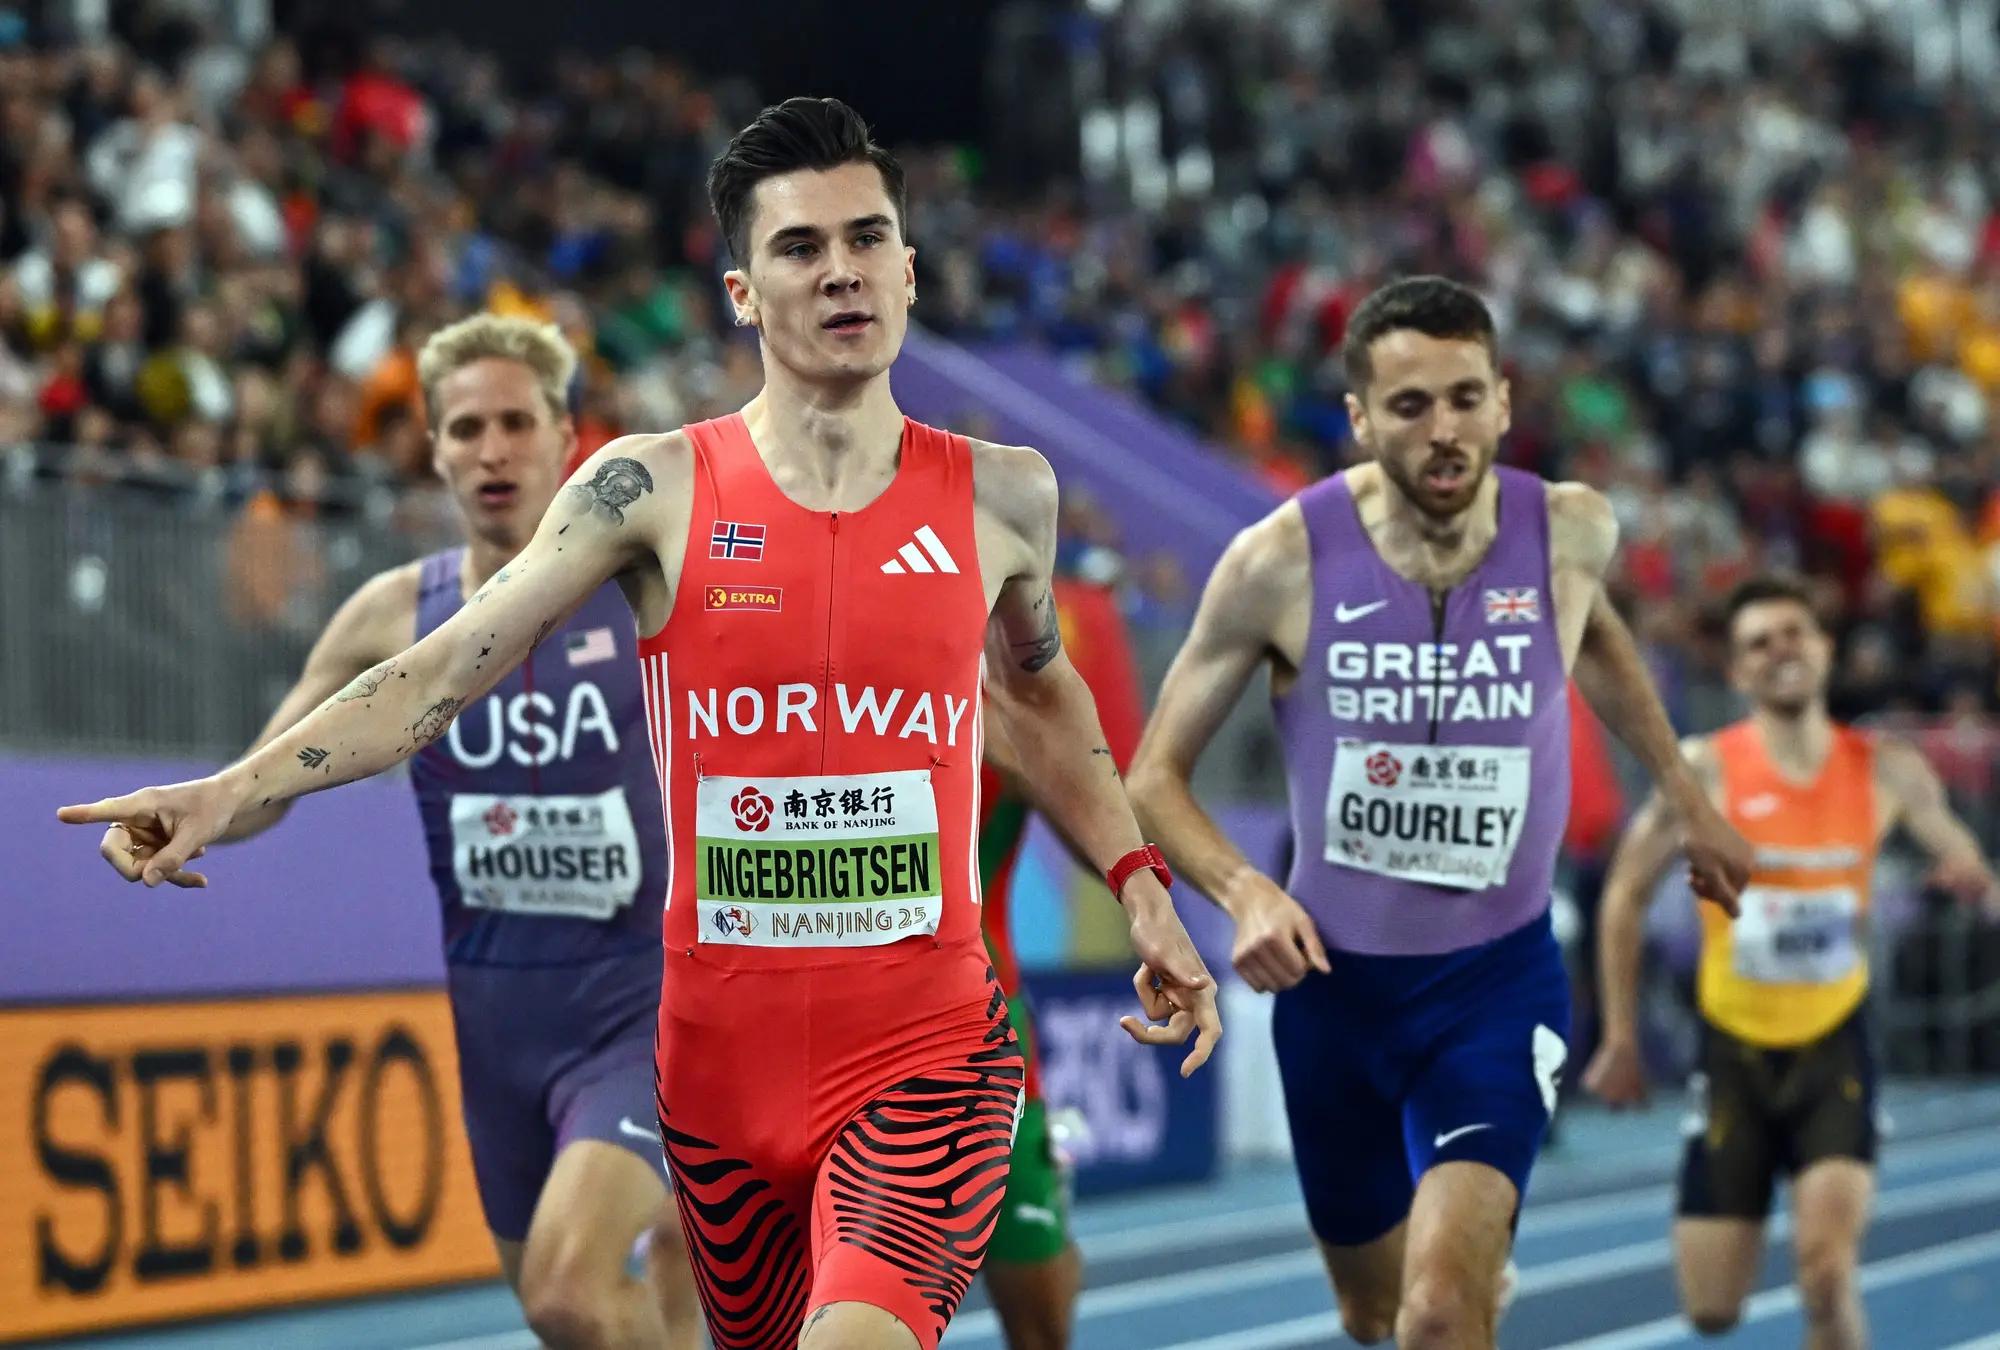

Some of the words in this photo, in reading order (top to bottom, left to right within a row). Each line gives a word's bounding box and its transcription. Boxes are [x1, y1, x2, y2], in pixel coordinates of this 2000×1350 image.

[730, 593, 776, 604] EXTRA
[1327, 634, 1532, 680] GREAT
[688, 682, 969, 746] NORWAY
[1327, 681, 1533, 723] BRITAIN
[449, 681, 620, 768] USA
[783, 786, 895, 818] 南京银行
[785, 821, 819, 830] BANK
[824, 820, 838, 829] OF
[843, 817, 896, 828] NANJING
[1340, 793, 1517, 847] GOURLEY
[469, 843, 628, 882] HOUSER
[707, 842, 930, 898] INGEBRIGTSEN
[772, 907, 892, 939] NANJING
[898, 906, 927, 929] 25
[31, 1021, 447, 1296] SEIKO
